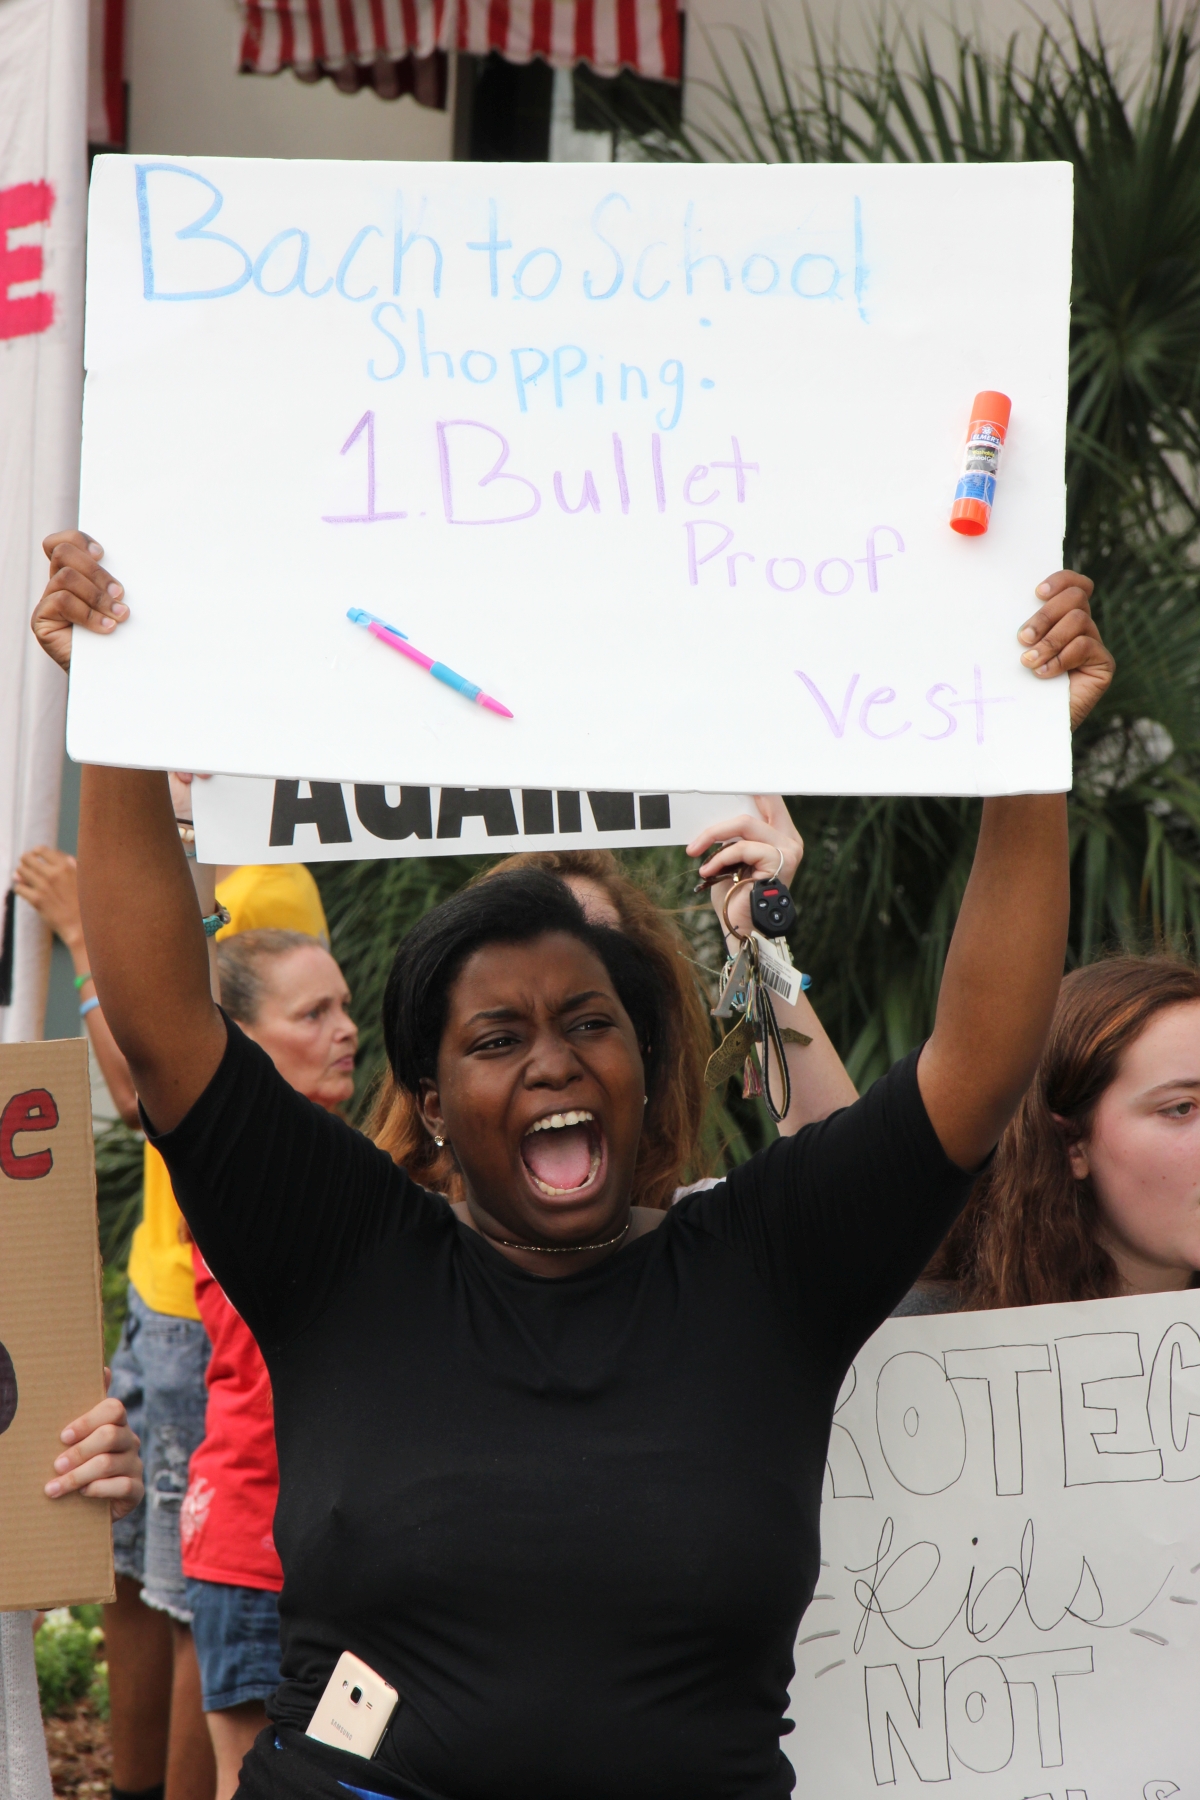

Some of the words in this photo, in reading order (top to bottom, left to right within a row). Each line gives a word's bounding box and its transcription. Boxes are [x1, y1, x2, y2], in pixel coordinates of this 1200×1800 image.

[466, 197, 562, 301] to
[436, 418, 760, 526] Bullet
[682, 519, 906, 596] Proof
[794, 663, 1016, 746] Vest
[330, 1718, 353, 1741] SAMSUNG
[864, 1645, 1094, 1786] NOT
